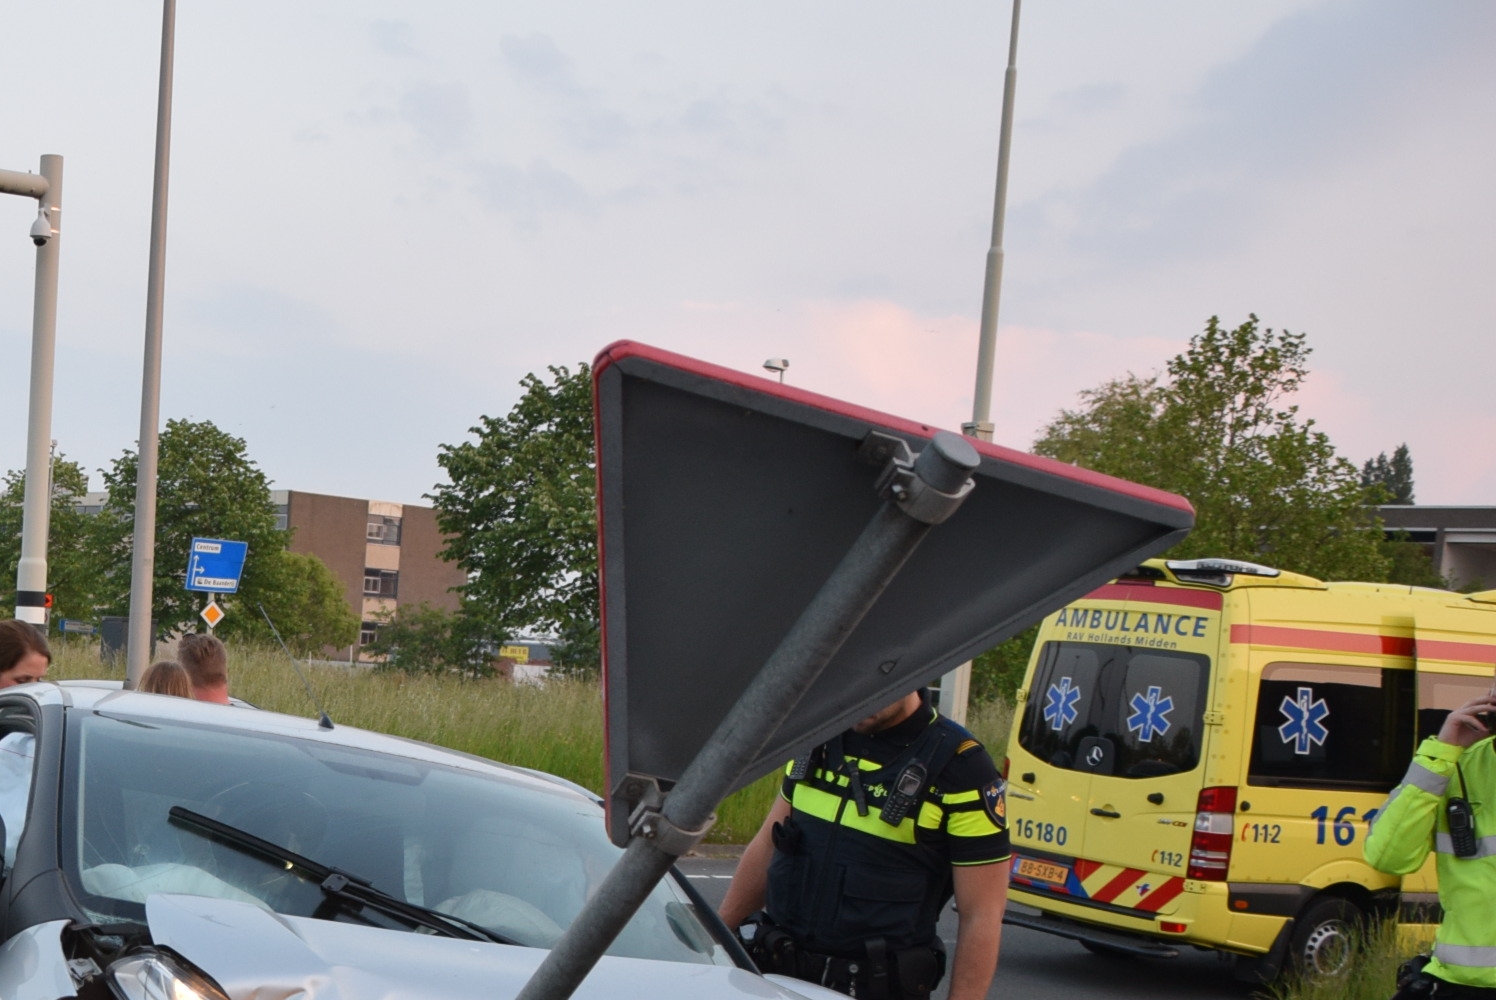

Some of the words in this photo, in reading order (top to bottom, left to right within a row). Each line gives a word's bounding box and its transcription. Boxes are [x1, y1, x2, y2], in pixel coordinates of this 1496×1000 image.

[1055, 608, 1209, 637] AMBULANCE
[1066, 632, 1085, 641] RAV
[1087, 633, 1132, 645] Hollands
[1134, 636, 1178, 649] Midden
[1015, 818, 1068, 847] 16180
[1310, 805, 1380, 846] 161
